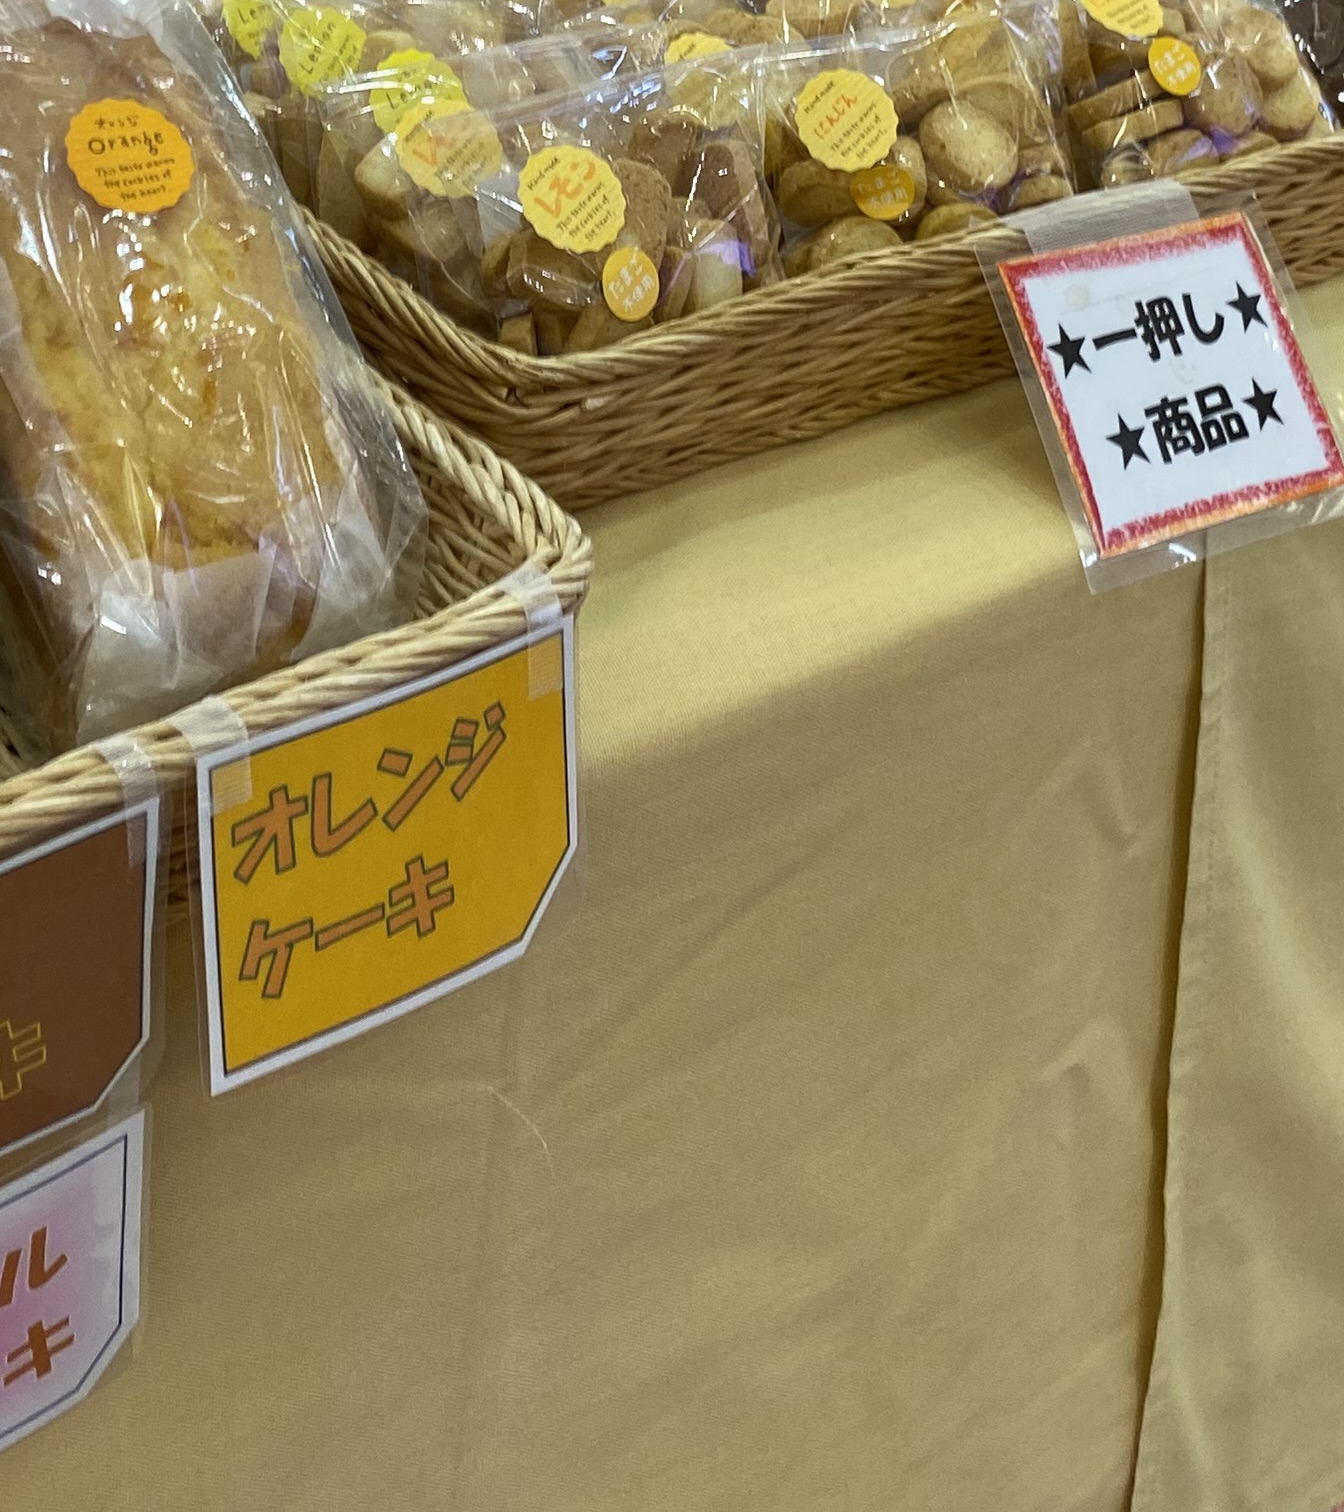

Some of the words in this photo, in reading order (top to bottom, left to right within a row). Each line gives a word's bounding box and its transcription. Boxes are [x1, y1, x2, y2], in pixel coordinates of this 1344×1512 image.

[534, 159, 597, 218] レモン
[1092, 293, 1225, 361] 一押し
[1144, 383, 1250, 464] 商品
[230, 702, 509, 883] オレンジ
[238, 854, 455, 998] ケーキ
